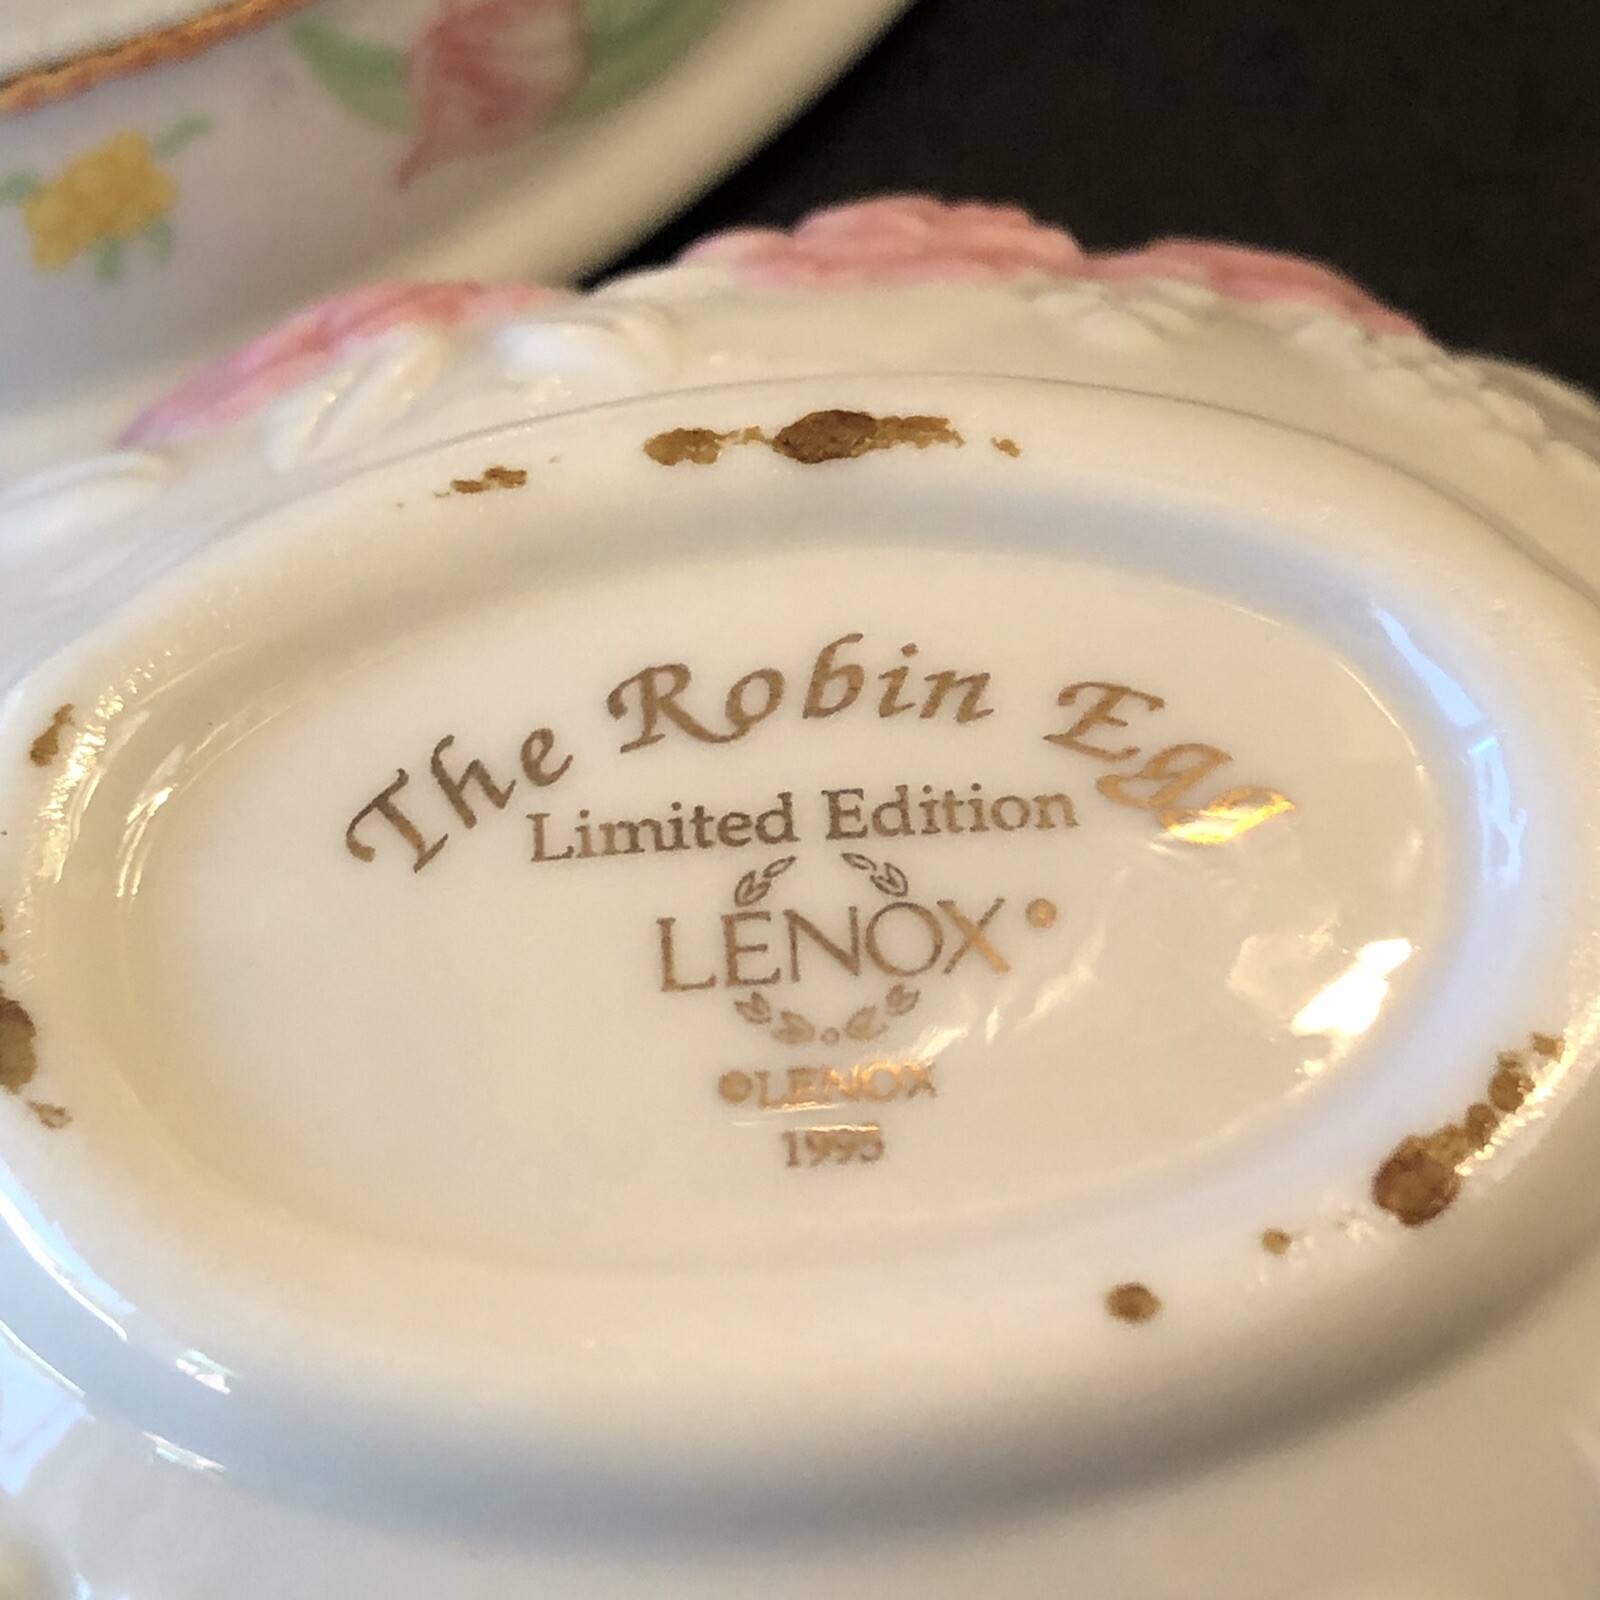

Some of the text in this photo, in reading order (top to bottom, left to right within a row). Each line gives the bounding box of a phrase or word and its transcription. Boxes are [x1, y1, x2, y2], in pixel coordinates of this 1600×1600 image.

[346, 725, 573, 873] The
[606, 632, 994, 753] Robin
[526, 783, 1080, 862] Limited Edition
[657, 899, 1011, 991] LENOX
